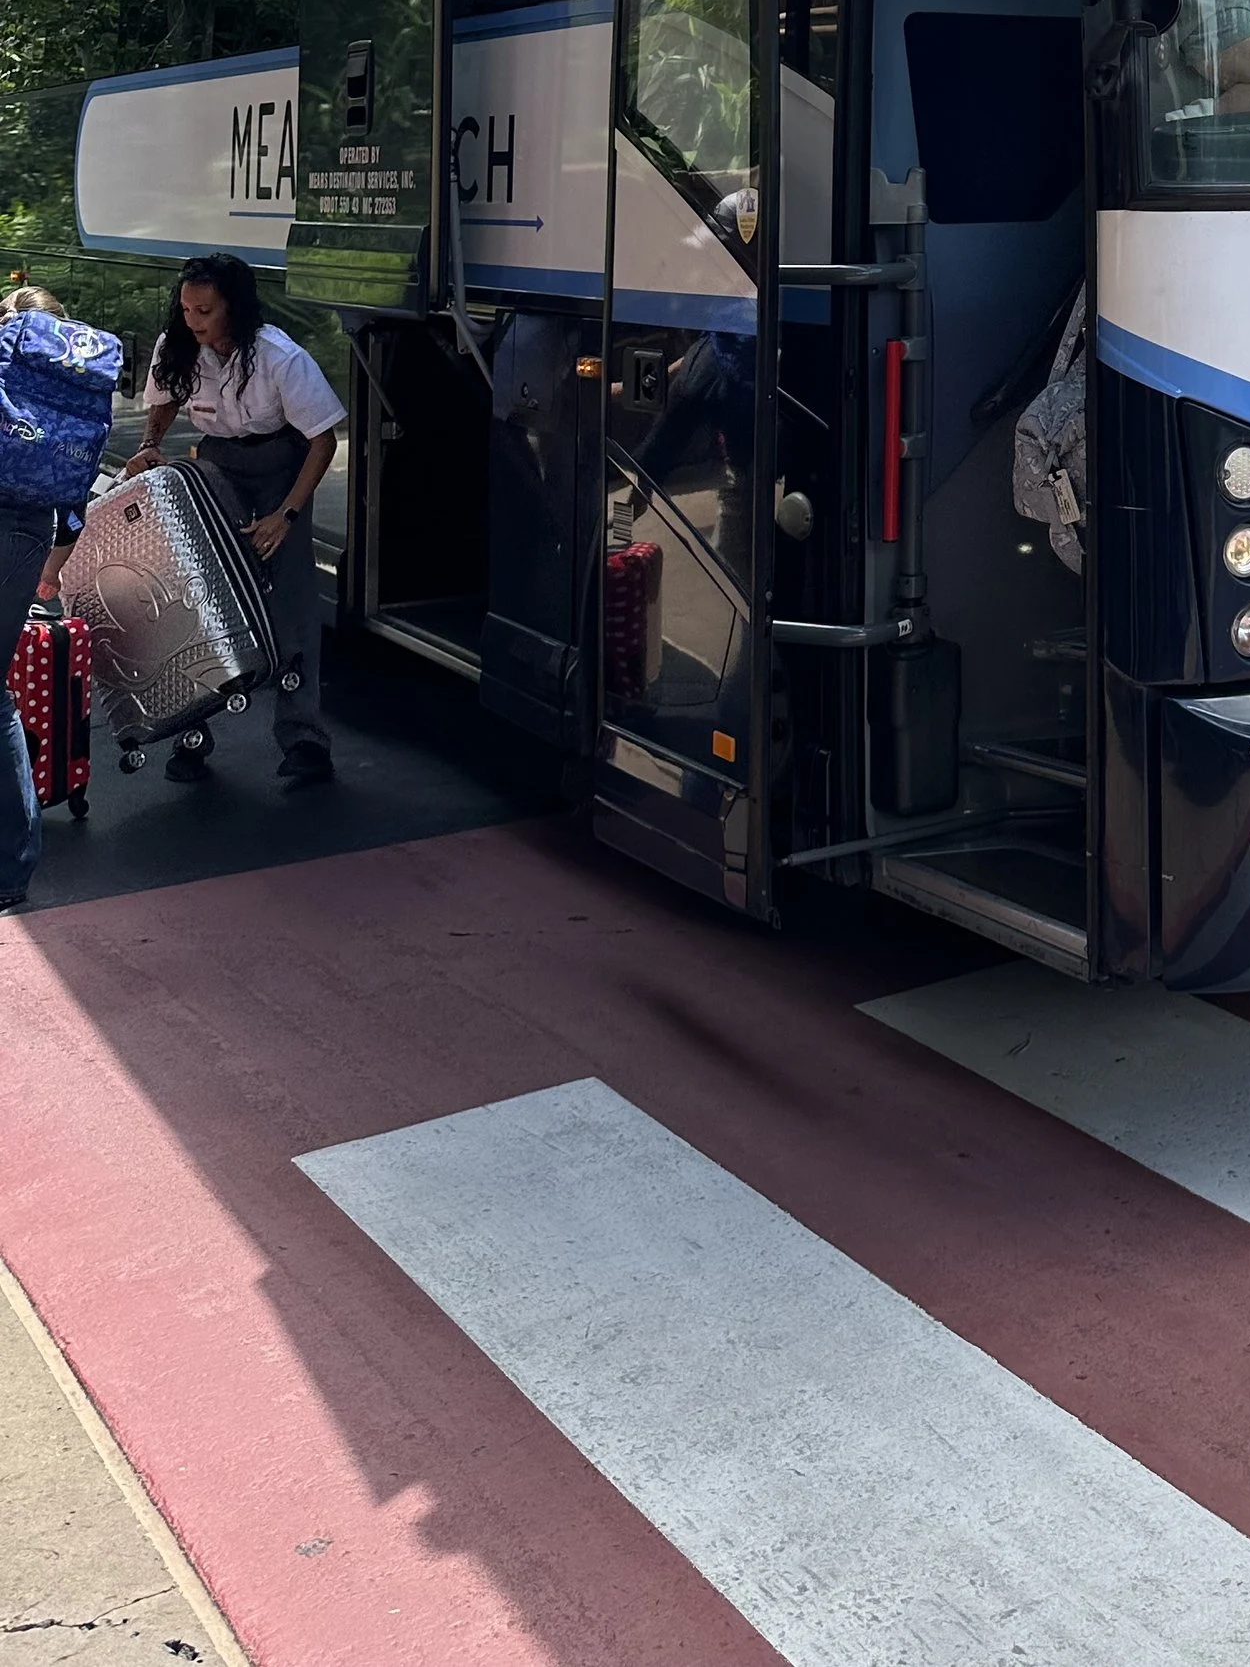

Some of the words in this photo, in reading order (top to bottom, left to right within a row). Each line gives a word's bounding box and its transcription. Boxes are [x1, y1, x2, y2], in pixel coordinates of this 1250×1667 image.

[230, 100, 297, 200] MEA
[455, 114, 515, 204] CH
[340, 146, 369, 164] OPERATED
[371, 146, 381, 164] BY
[308, 172, 328, 189] MEARS
[329, 171, 366, 189] DESTINATION
[367, 170, 399, 192] SERVICES,
[401, 170, 416, 189] INC.
[362, 197, 373, 214] MC
